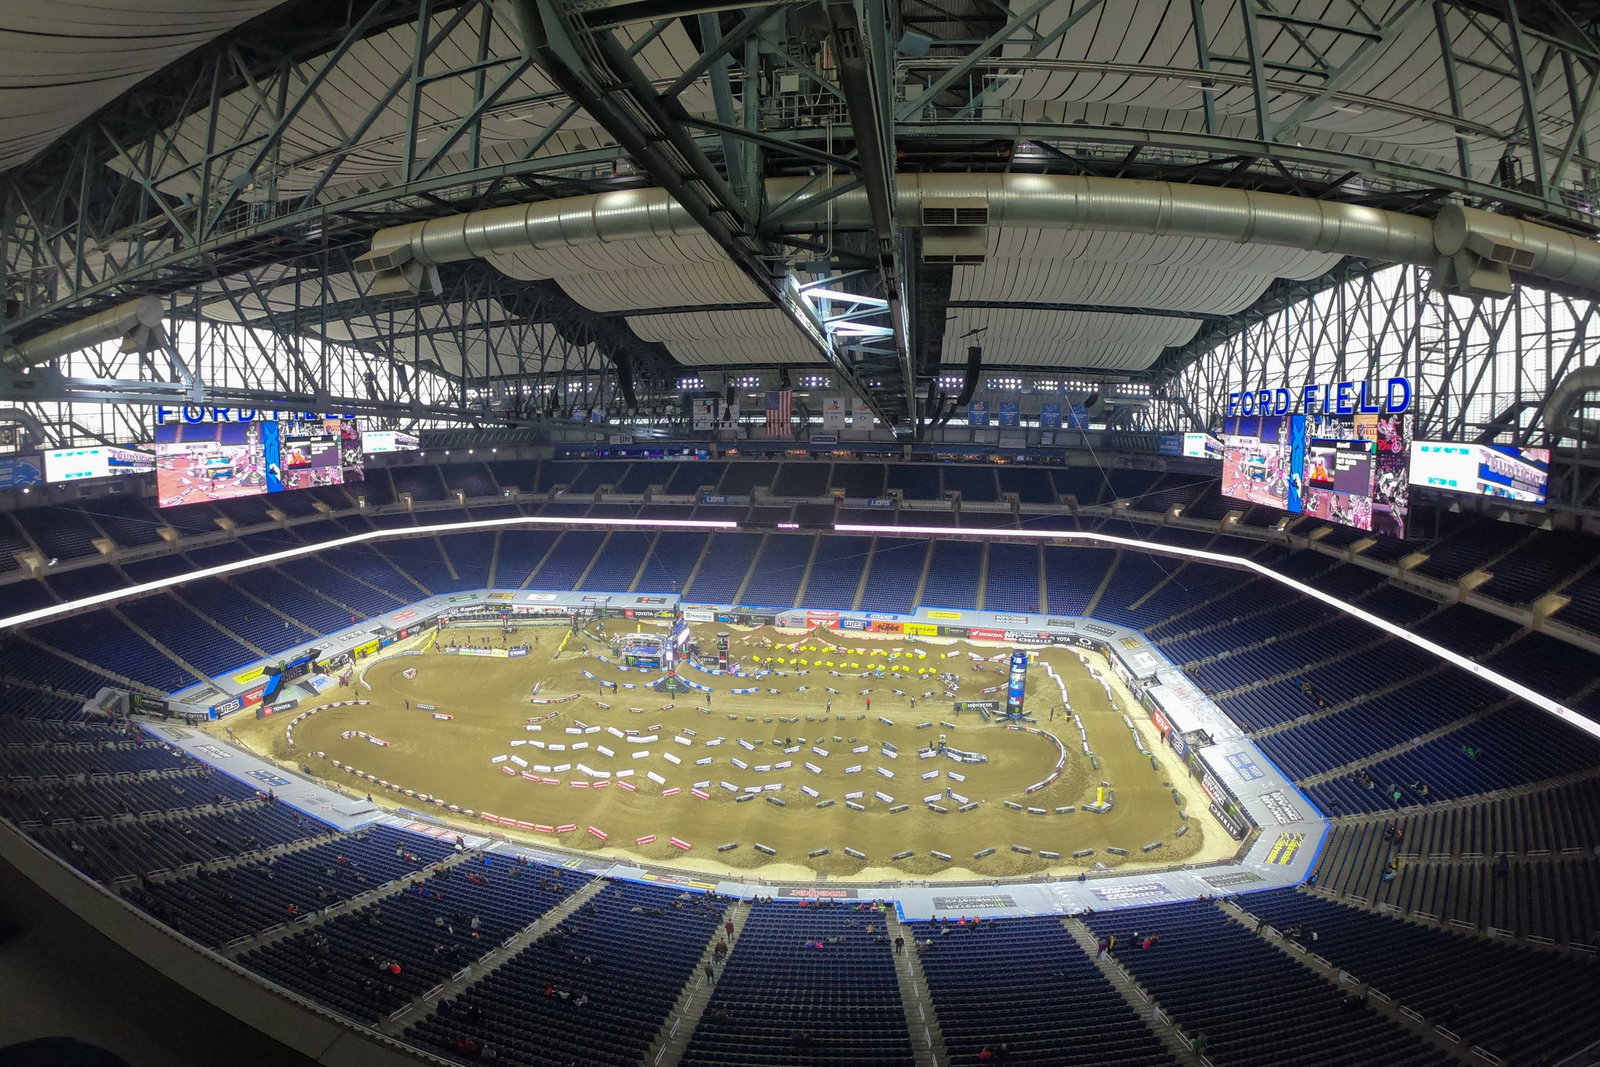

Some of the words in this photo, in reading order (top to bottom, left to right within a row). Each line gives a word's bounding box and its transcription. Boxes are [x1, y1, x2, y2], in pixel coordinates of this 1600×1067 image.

[1228, 387, 1290, 417] FORD
[1303, 377, 1412, 414] FIELD
[273, 703, 291, 712] TOYOTA
[789, 888, 847, 898] meijer
